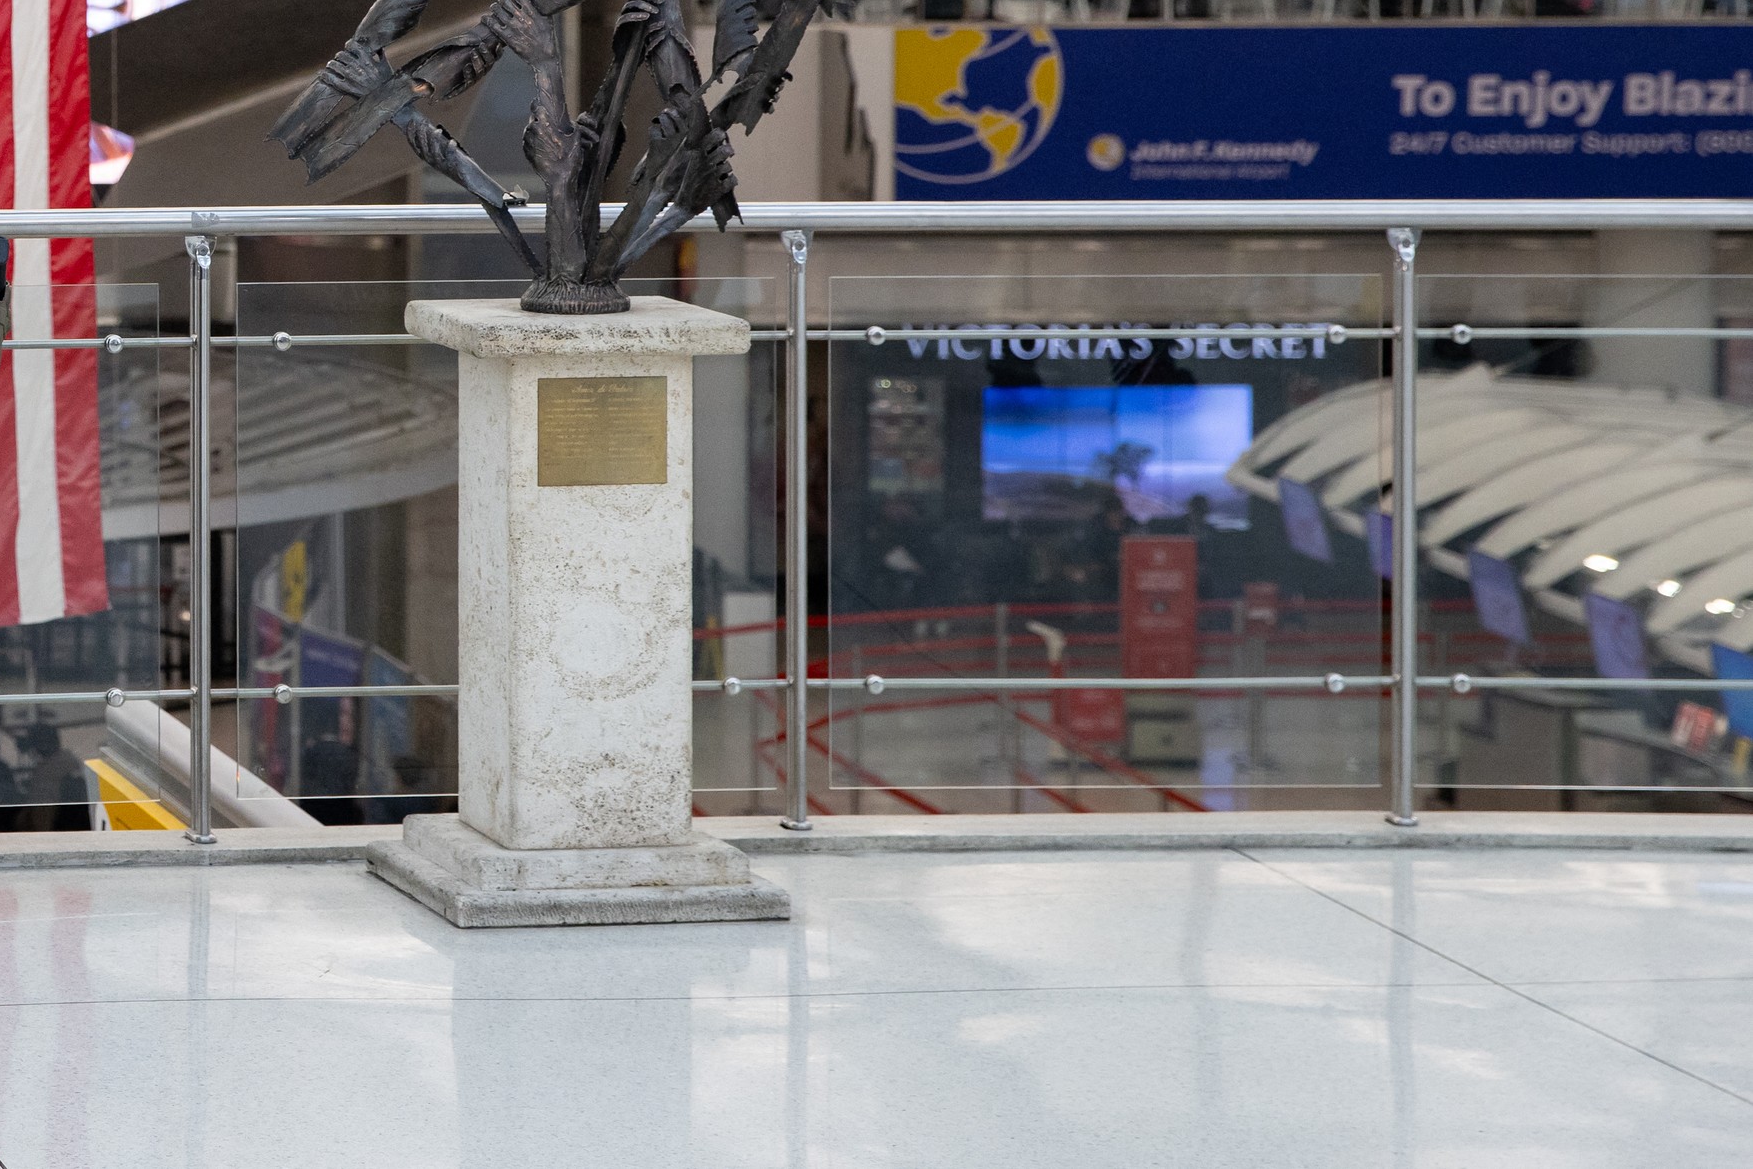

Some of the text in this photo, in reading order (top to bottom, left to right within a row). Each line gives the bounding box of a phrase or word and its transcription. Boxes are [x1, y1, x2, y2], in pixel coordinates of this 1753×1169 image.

[1392, 74, 1456, 117] To
[1467, 70, 1614, 128] Enjoy
[1450, 132, 1577, 155] Customer
[1167, 320, 1330, 361] SECRET
